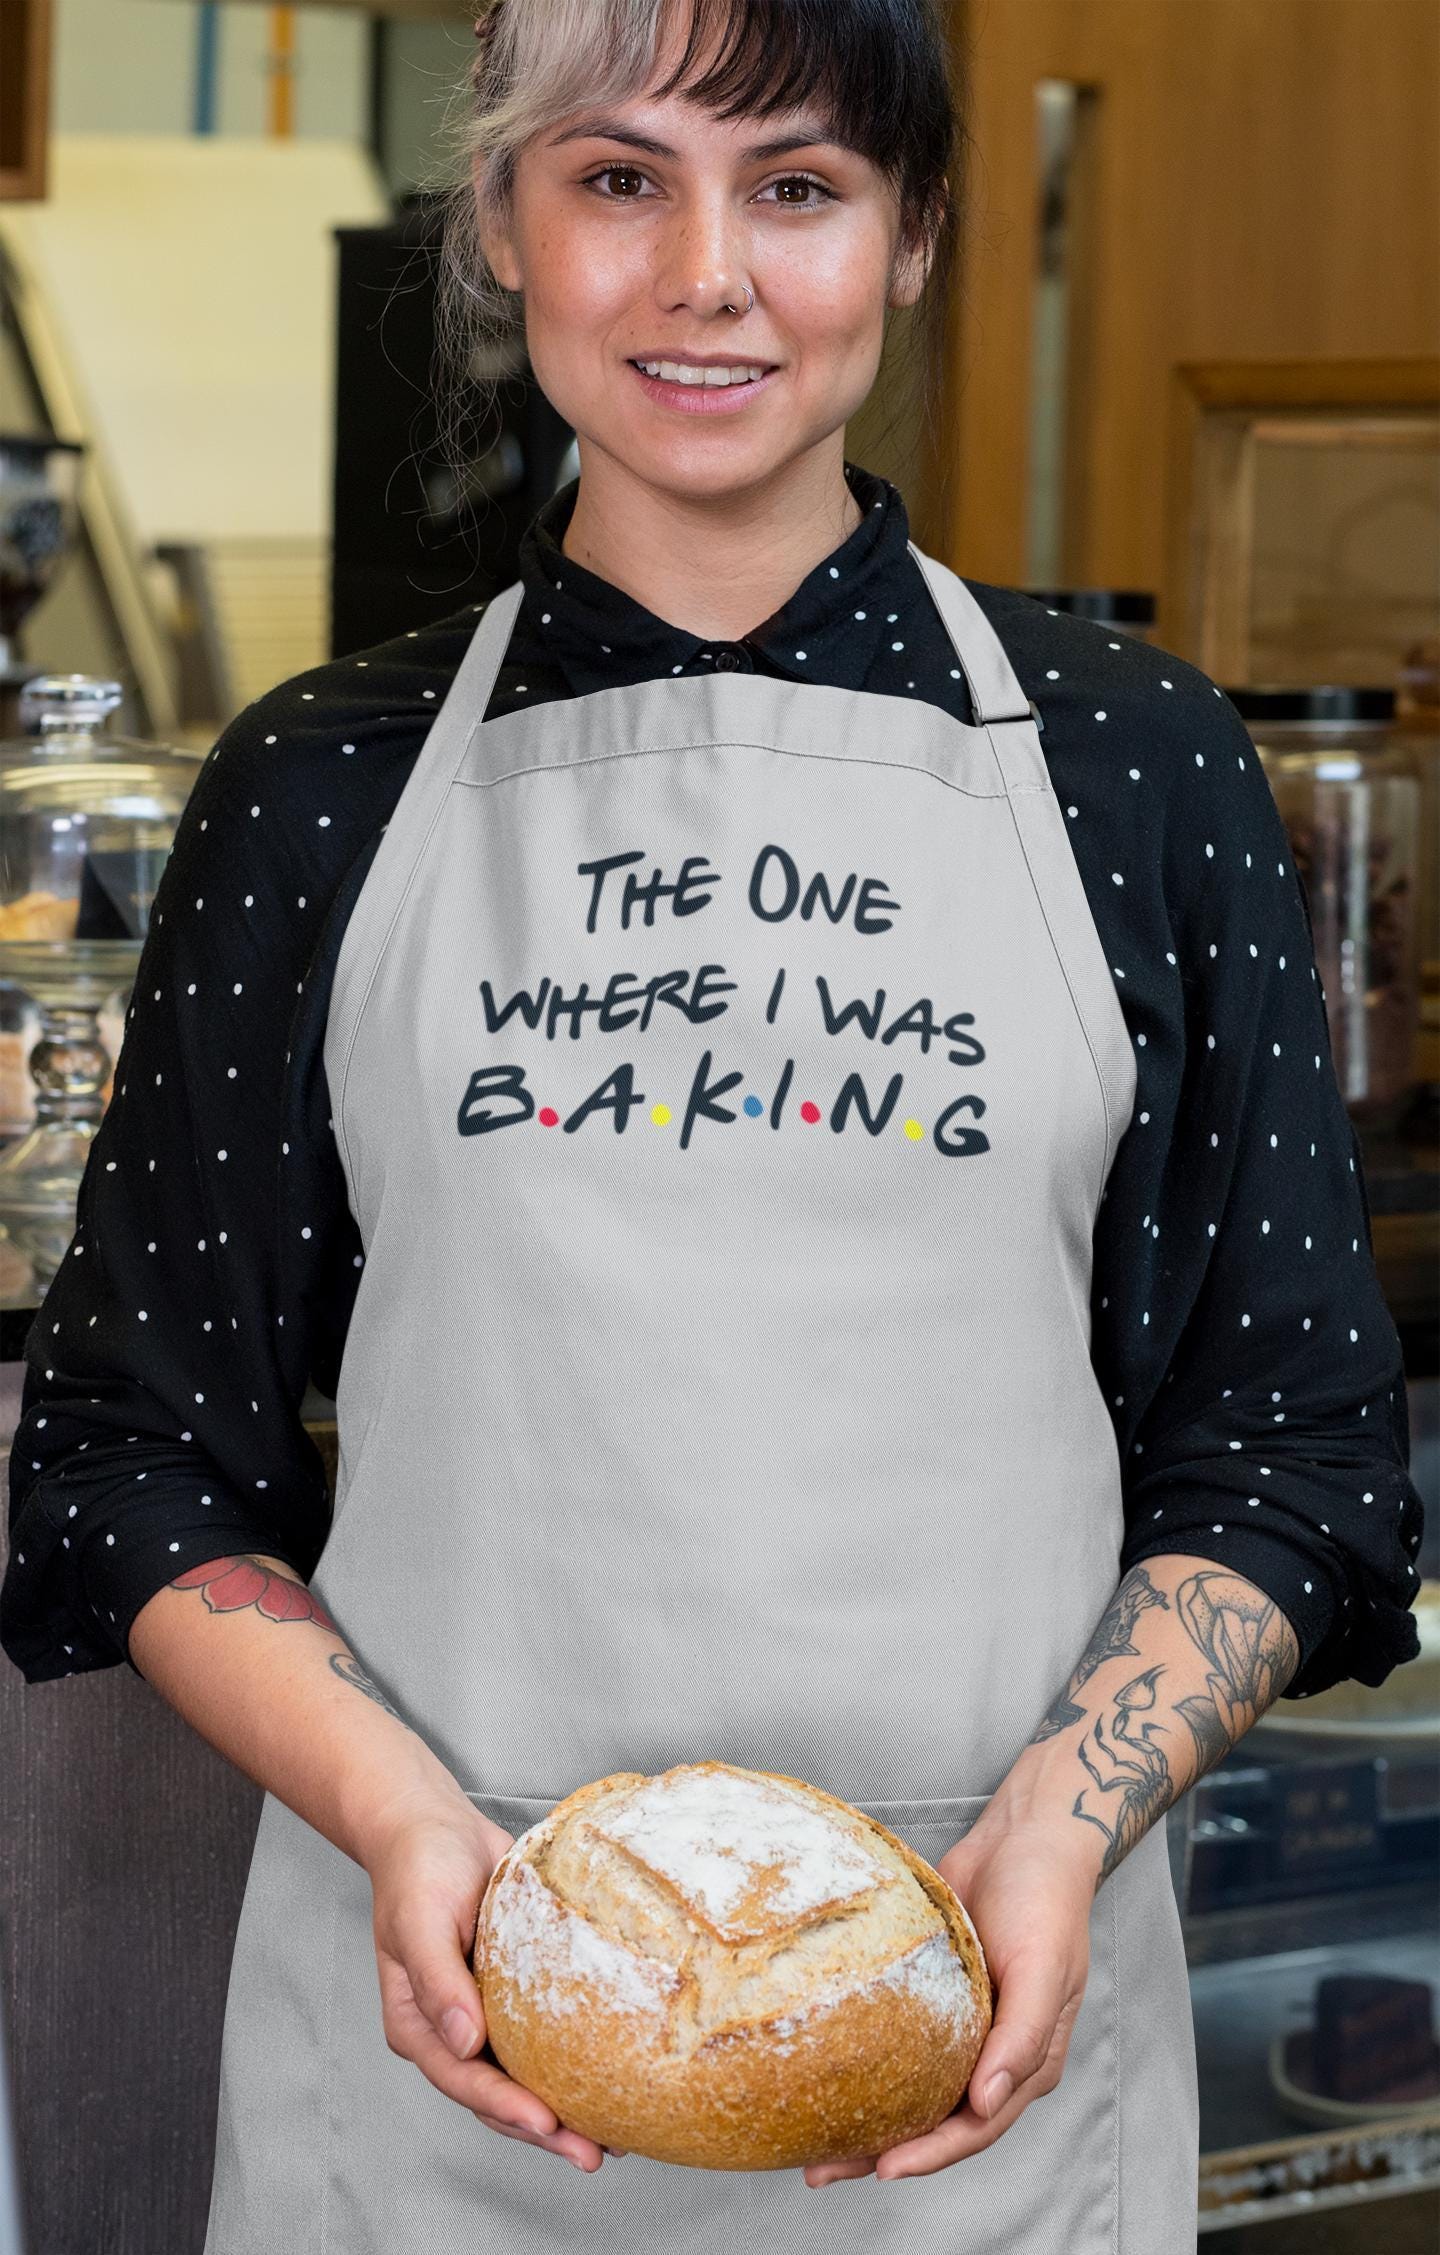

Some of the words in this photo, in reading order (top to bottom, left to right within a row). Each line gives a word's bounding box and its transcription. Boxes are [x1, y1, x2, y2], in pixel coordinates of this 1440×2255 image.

[578, 852, 720, 933] THE
[749, 845, 900, 934] ONE
[480, 965, 737, 1040] WHERE
[767, 969, 784, 1024] I
[817, 976, 985, 1066] WAS
